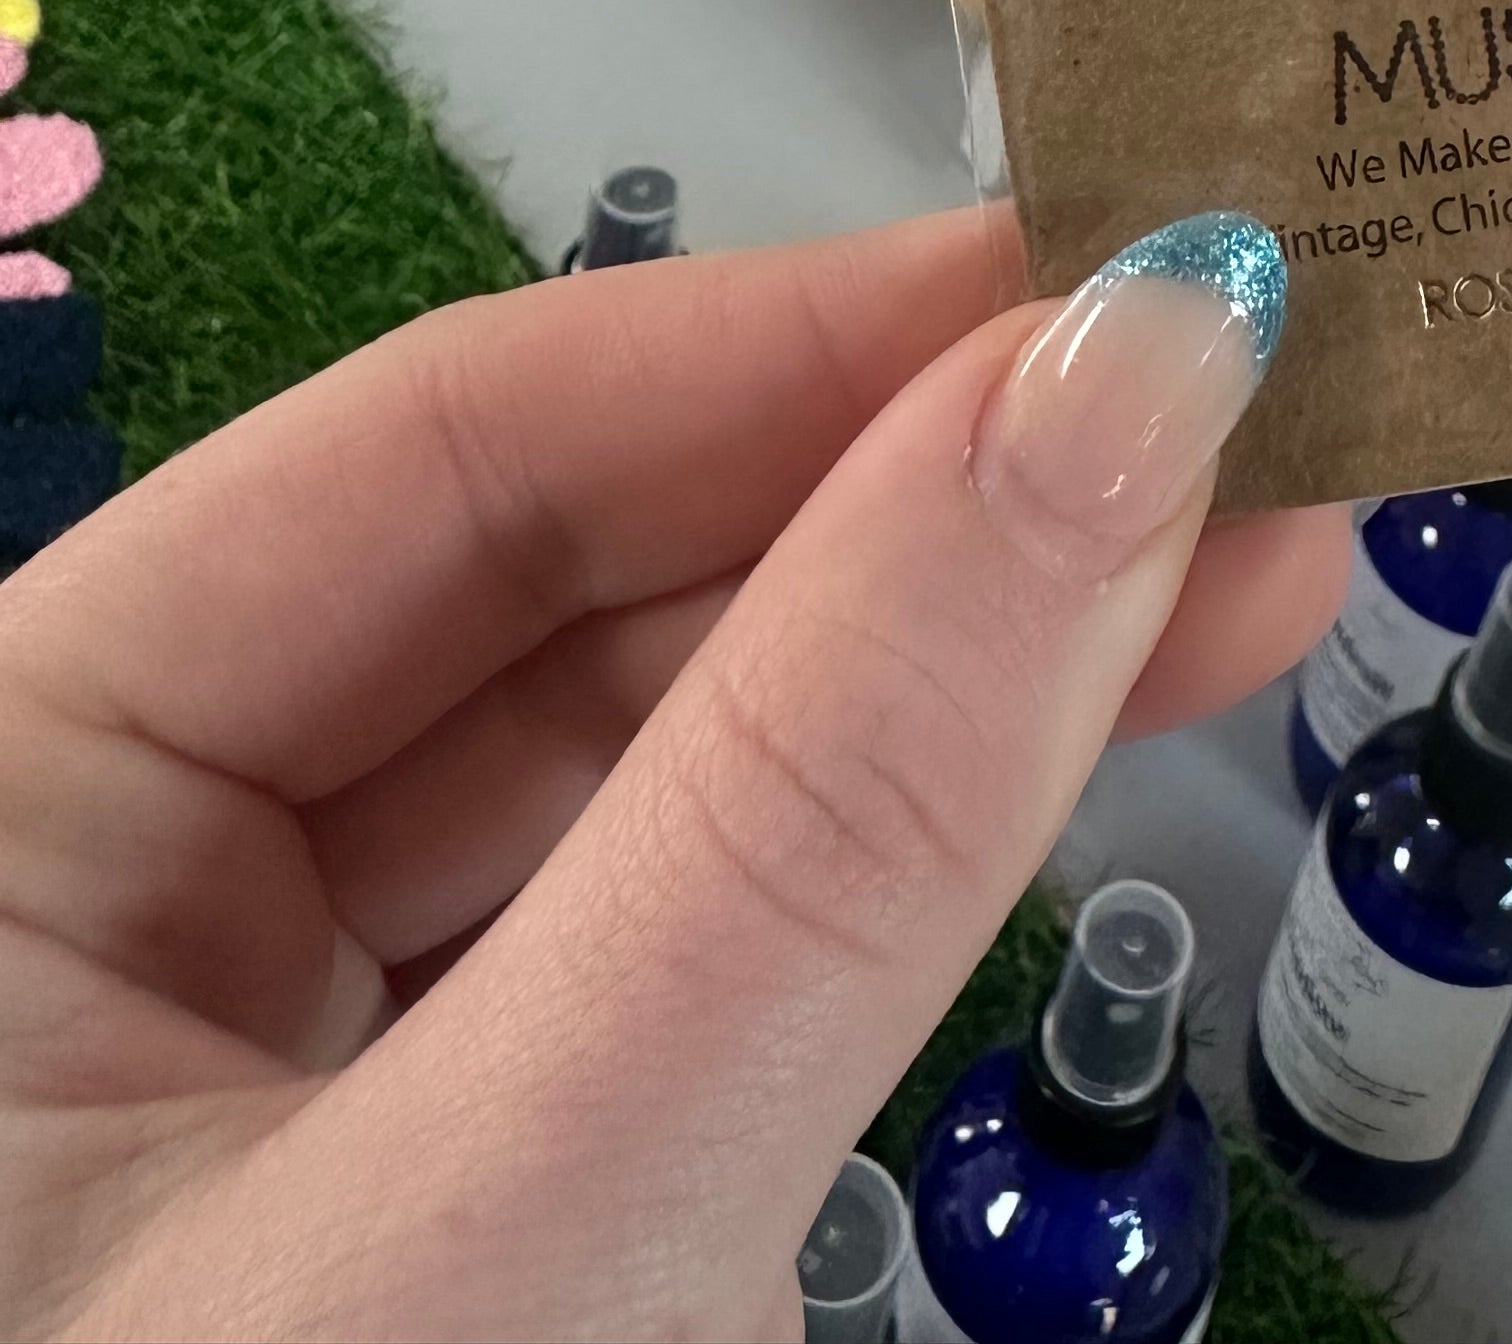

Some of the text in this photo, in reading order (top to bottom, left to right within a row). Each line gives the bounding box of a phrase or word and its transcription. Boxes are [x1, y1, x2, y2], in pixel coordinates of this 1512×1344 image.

[1316, 149, 1386, 192] We
[1400, 128, 1511, 179] Make
[1278, 214, 1424, 261] intage,
